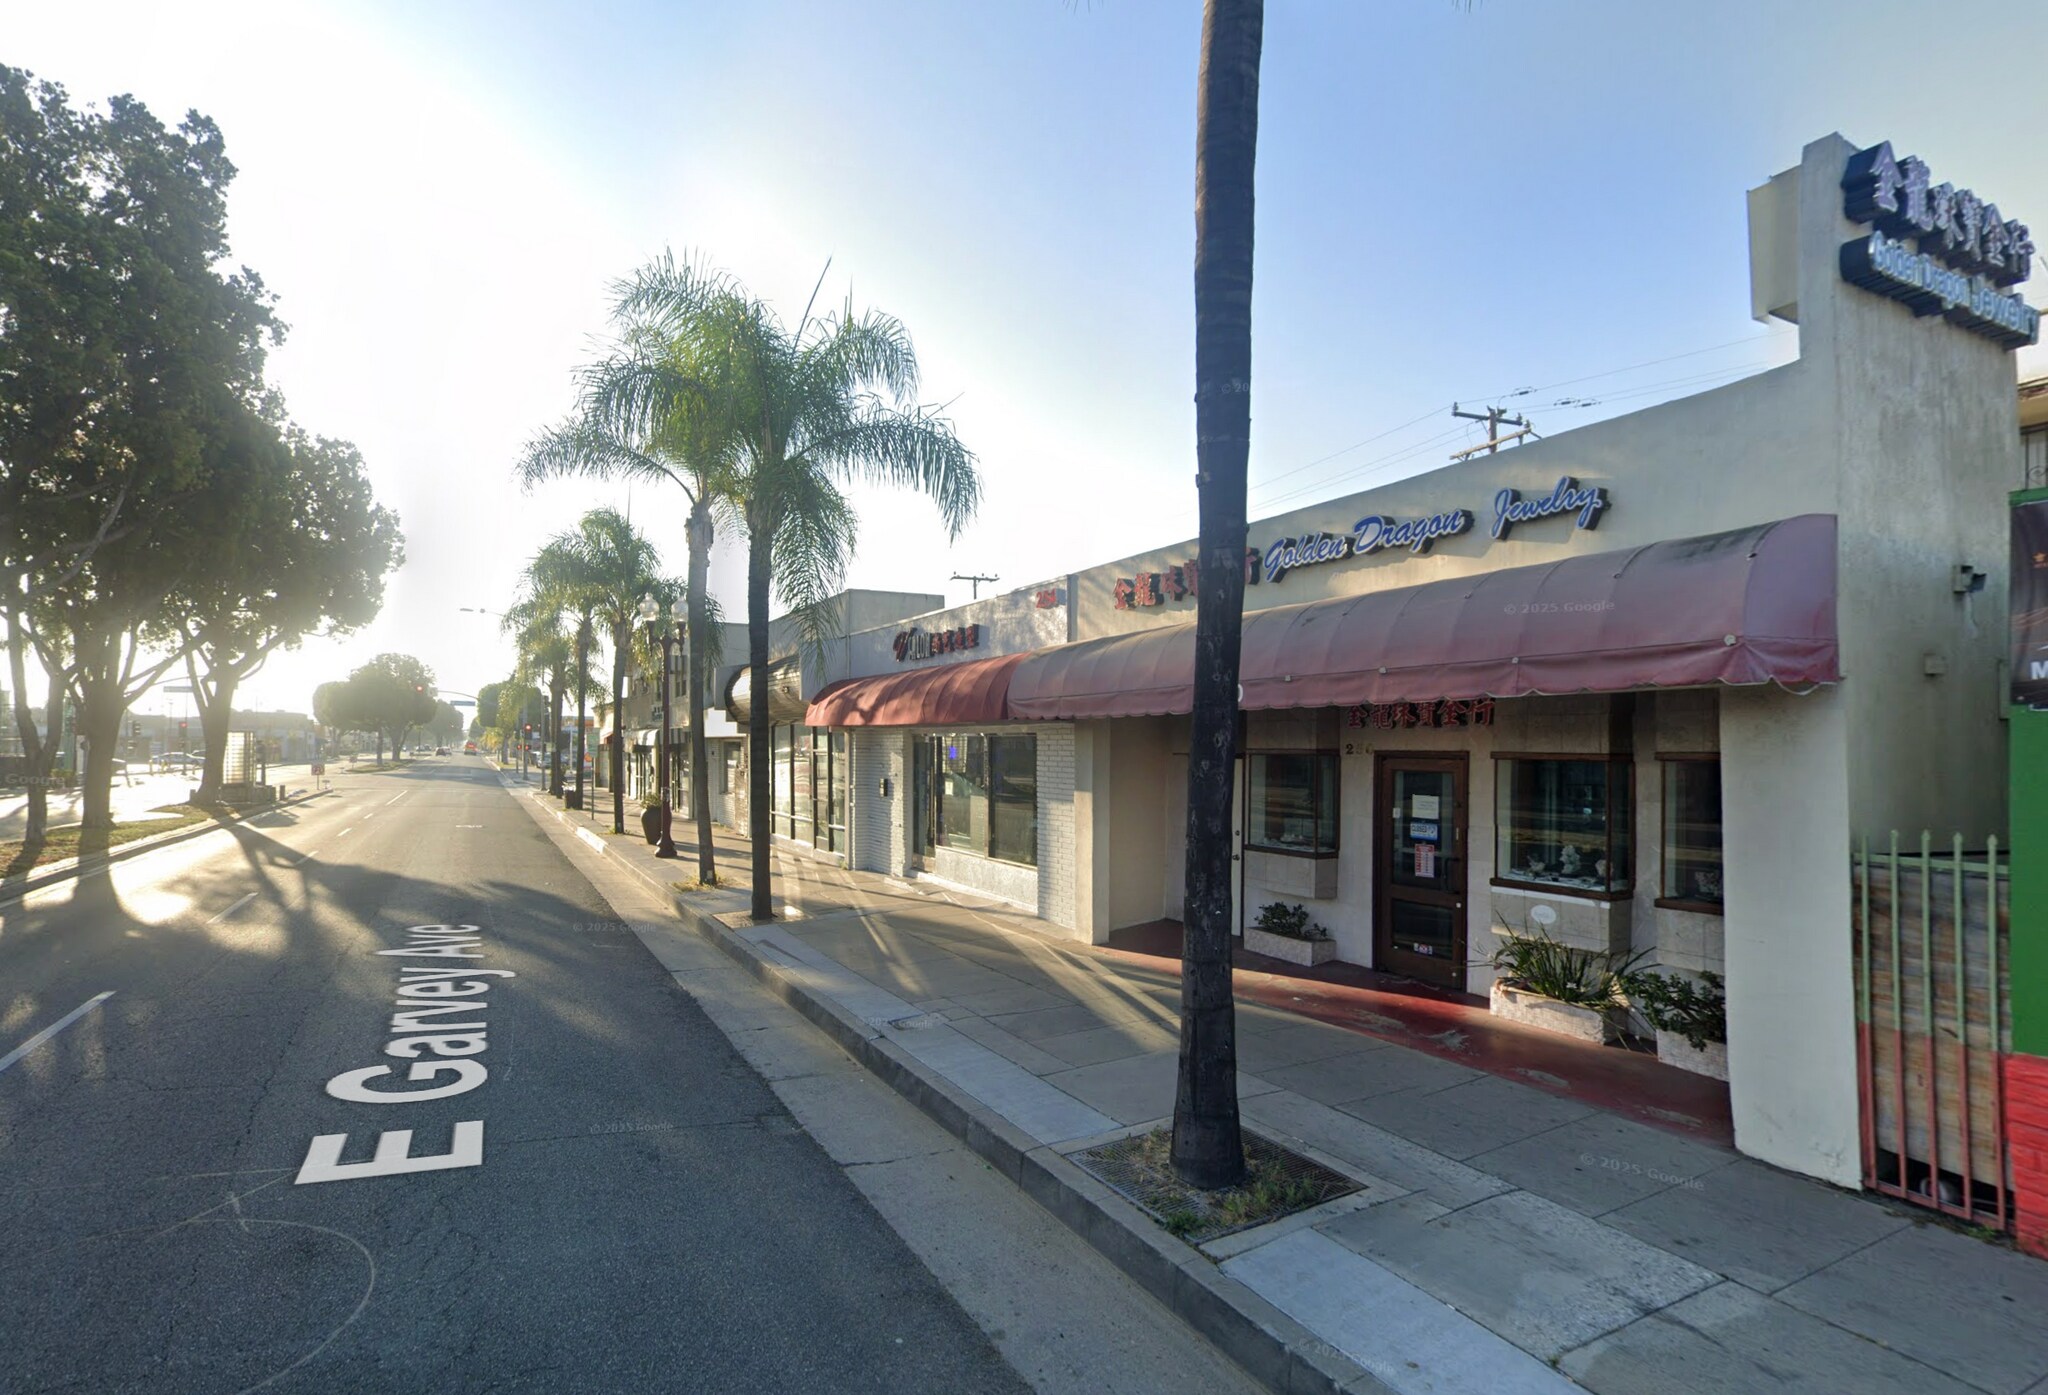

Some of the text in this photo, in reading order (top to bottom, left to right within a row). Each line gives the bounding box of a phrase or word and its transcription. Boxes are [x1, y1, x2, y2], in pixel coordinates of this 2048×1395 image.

[1867, 229, 1923, 287] Golden
[1921, 253, 1971, 310] Dragon
[1263, 475, 1604, 583] Golden Dragon Jewelry
